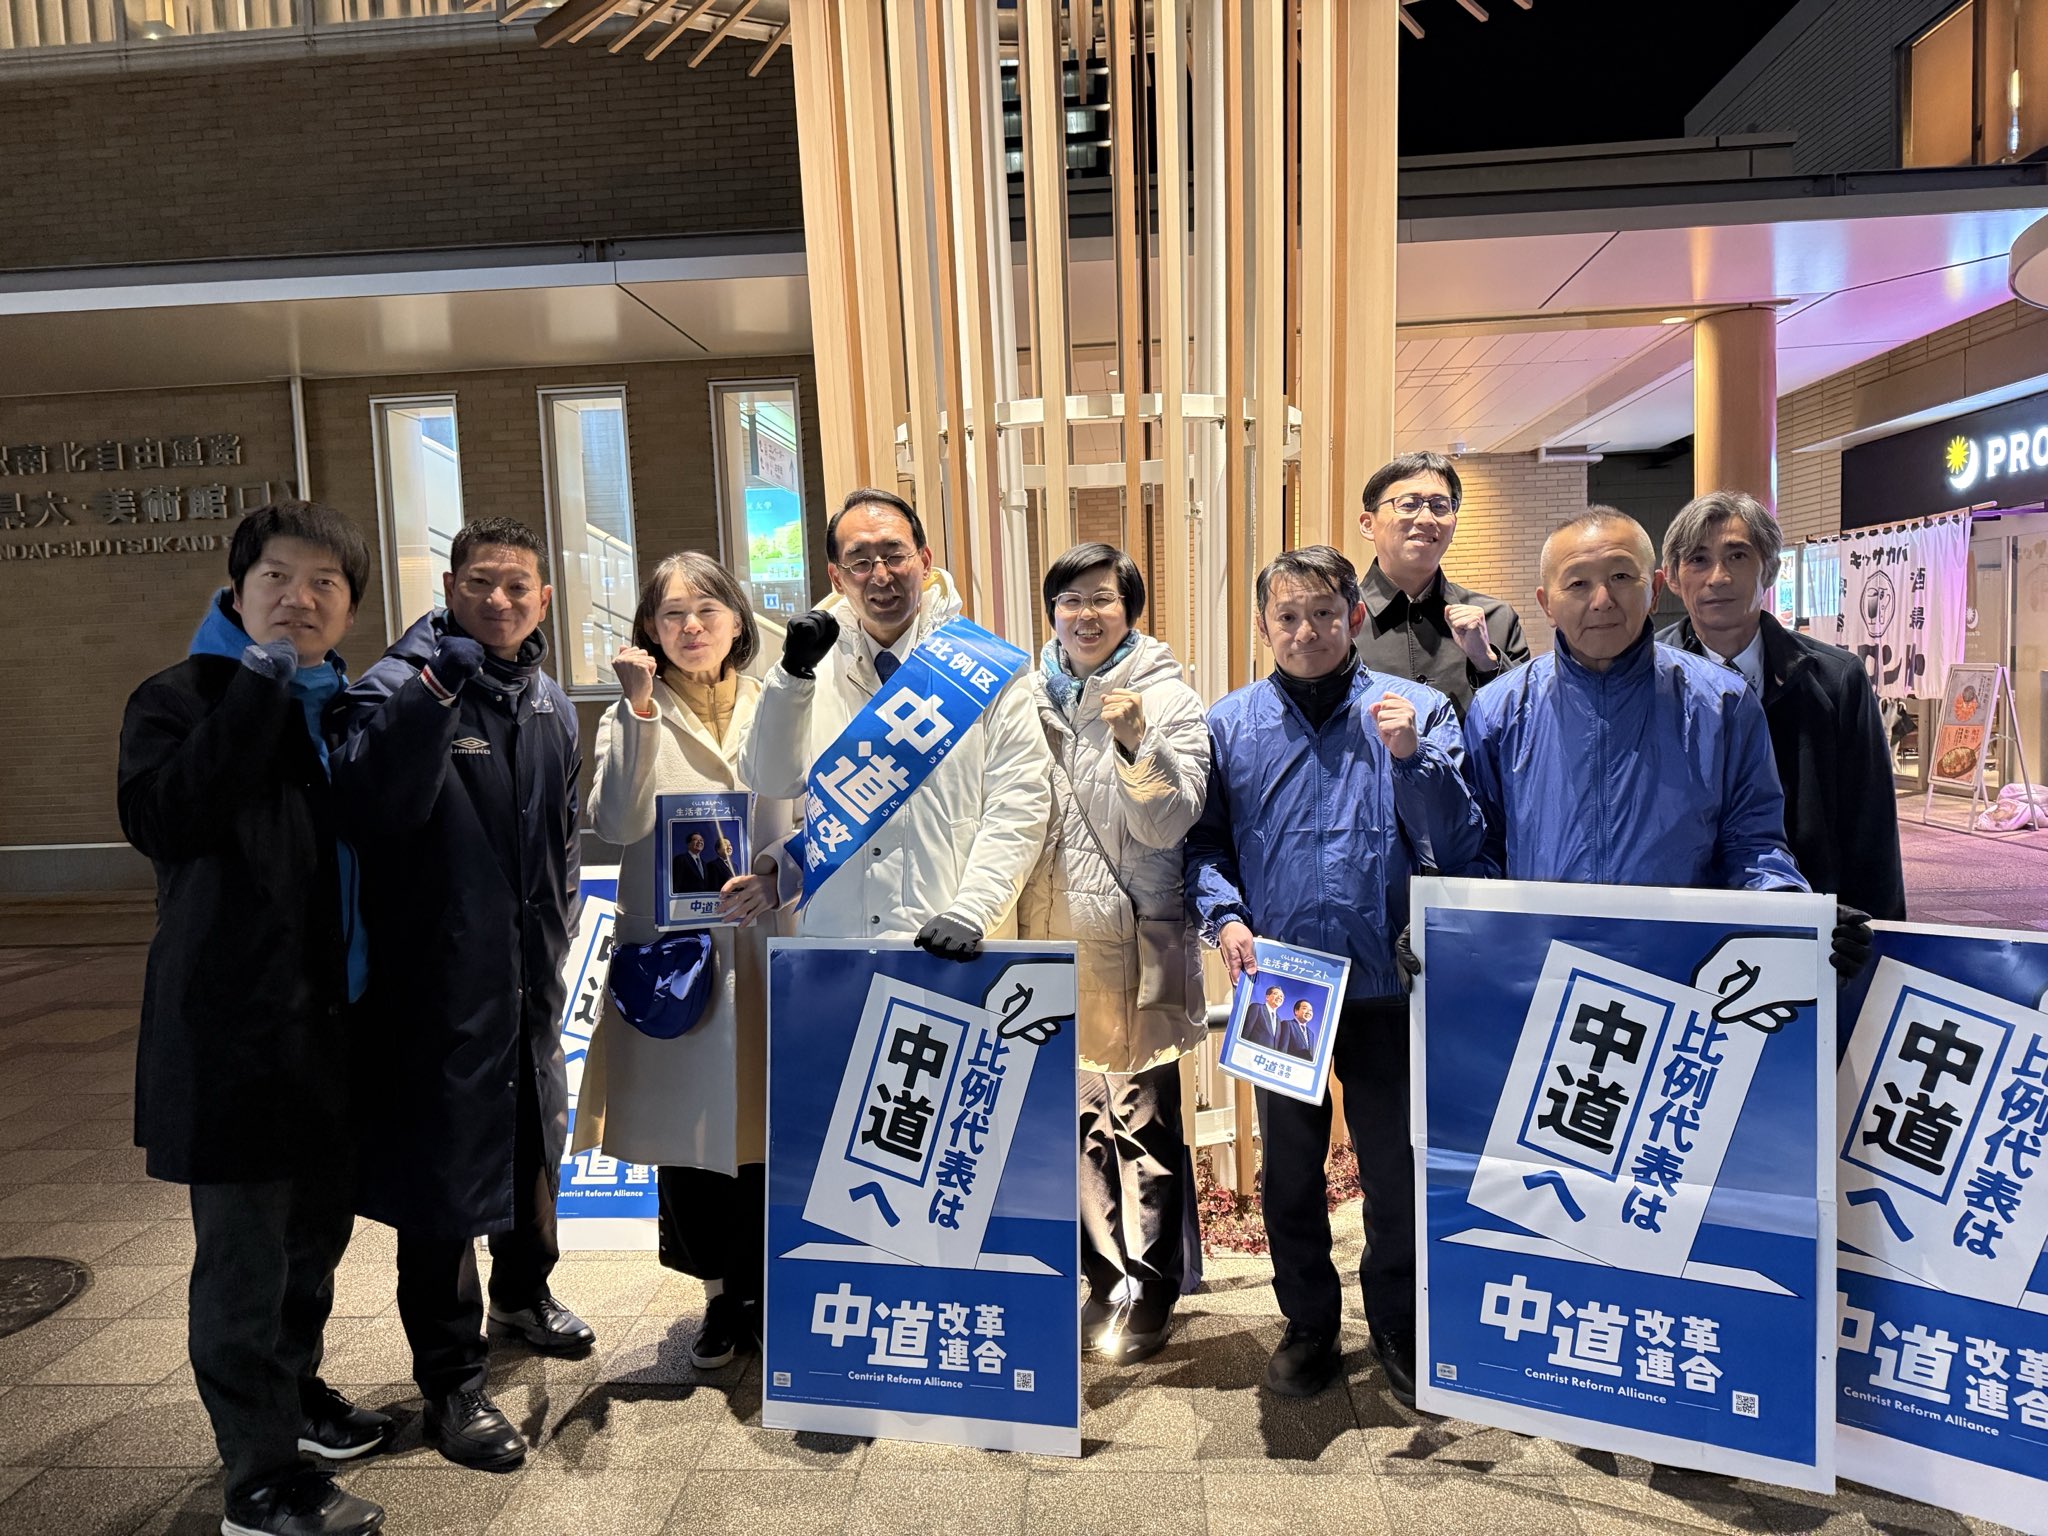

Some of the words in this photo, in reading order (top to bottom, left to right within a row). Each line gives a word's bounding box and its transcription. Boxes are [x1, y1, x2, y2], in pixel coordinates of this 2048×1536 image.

[1986, 427, 2048, 478] PRO
[1850, 543, 1909, 569] キッサカバ
[1909, 568, 1926, 630] 酒場
[925, 637, 998, 695] 比例区
[1836, 643, 1925, 692] ロント
[815, 686, 954, 825] 中道
[675, 807, 737, 817] 生活者ファースト
[1262, 958, 1329, 979] 生活者ファースト
[928, 1028, 1010, 1230] 比例代表は
[1621, 1010, 1729, 1233] 比例代表は
[561, 1133, 618, 1184] 道
[811, 1283, 933, 1369] 中道
[938, 1302, 1005, 1338] 改革
[1480, 1274, 1629, 1377] 中道
[1635, 1308, 1721, 1353] 改革
[848, 1371, 885, 1384] Centrist
[886, 1374, 922, 1386] Reform
[924, 1376, 963, 1389] Alliance
[938, 1337, 1007, 1375] 連合
[1636, 1345, 1723, 1394] 連合
[1965, 1336, 2048, 1389] 改革
[1525, 1367, 1569, 1385] Centrist
[1571, 1375, 1614, 1394] Reform
[1618, 1386, 1667, 1405] Alliance
[1843, 1386, 1891, 1408] Centrist
[1895, 1399, 1941, 1422] Reform
[1945, 1414, 1999, 1437] Alliance
[1965, 1374, 2048, 1430] 連合
